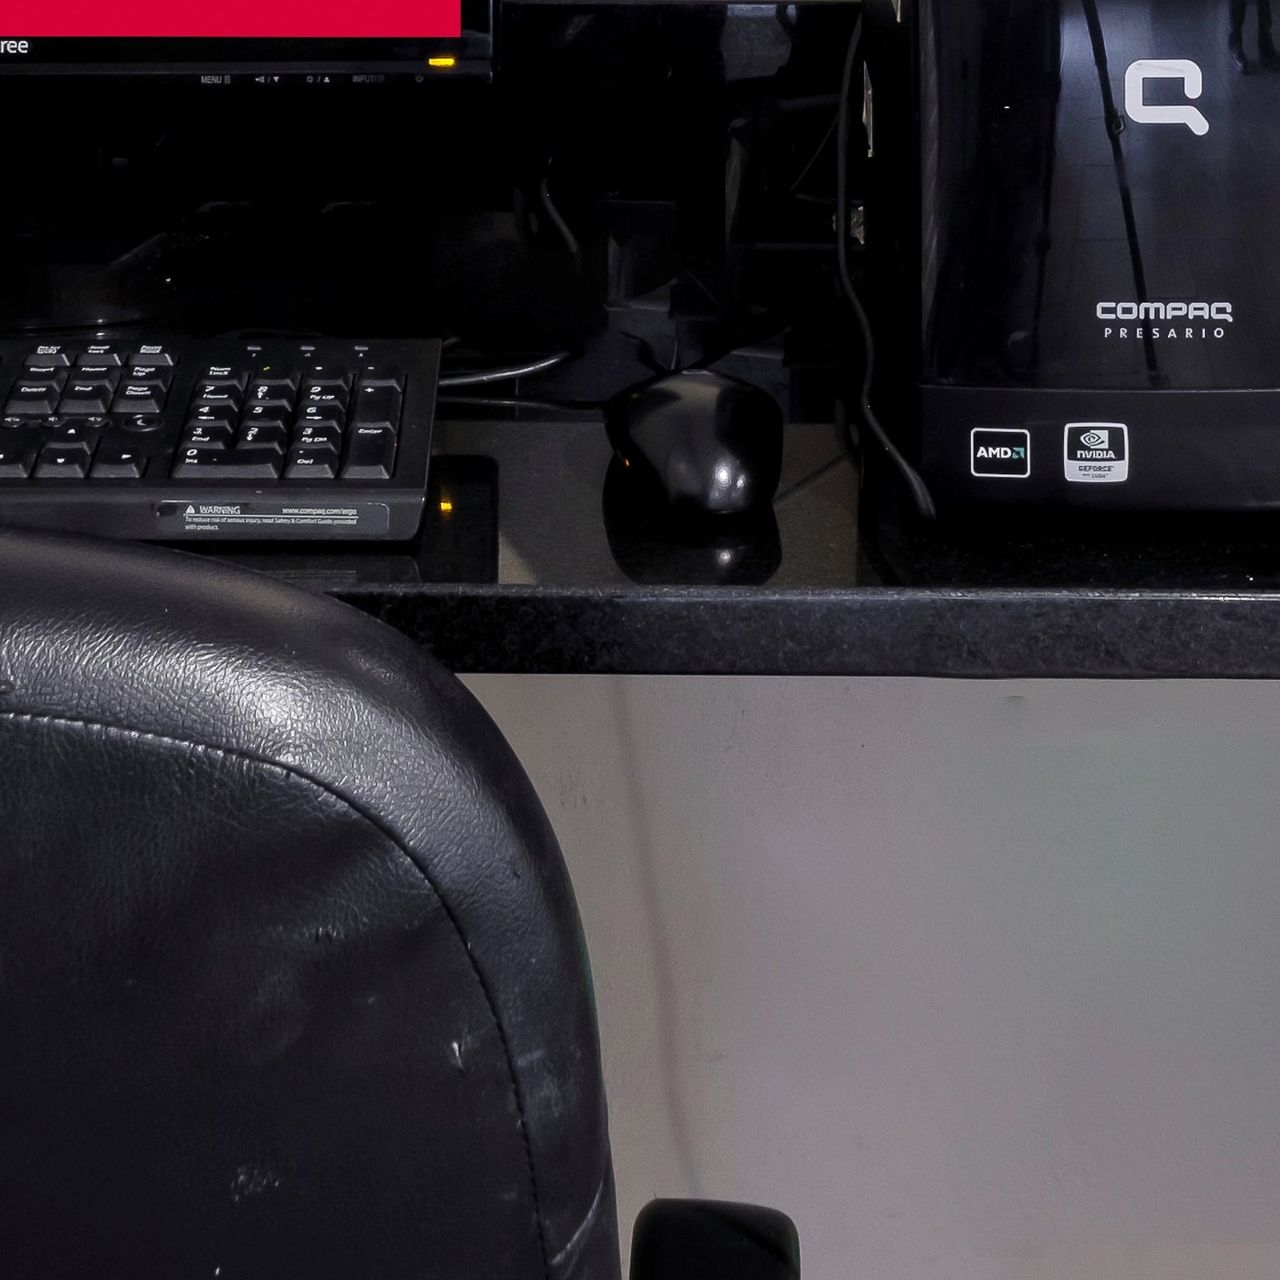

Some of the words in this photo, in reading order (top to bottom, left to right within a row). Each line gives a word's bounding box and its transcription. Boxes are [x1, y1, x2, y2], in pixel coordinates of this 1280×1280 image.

[200, 75, 222, 85] MENU
[1096, 302, 1233, 322] COMPAQ
[1104, 327, 1225, 338] PRESARIO
[976, 446, 1012, 459] AMD
[1077, 450, 1116, 459] NVIDIA
[199, 505, 241, 515] WARNING
